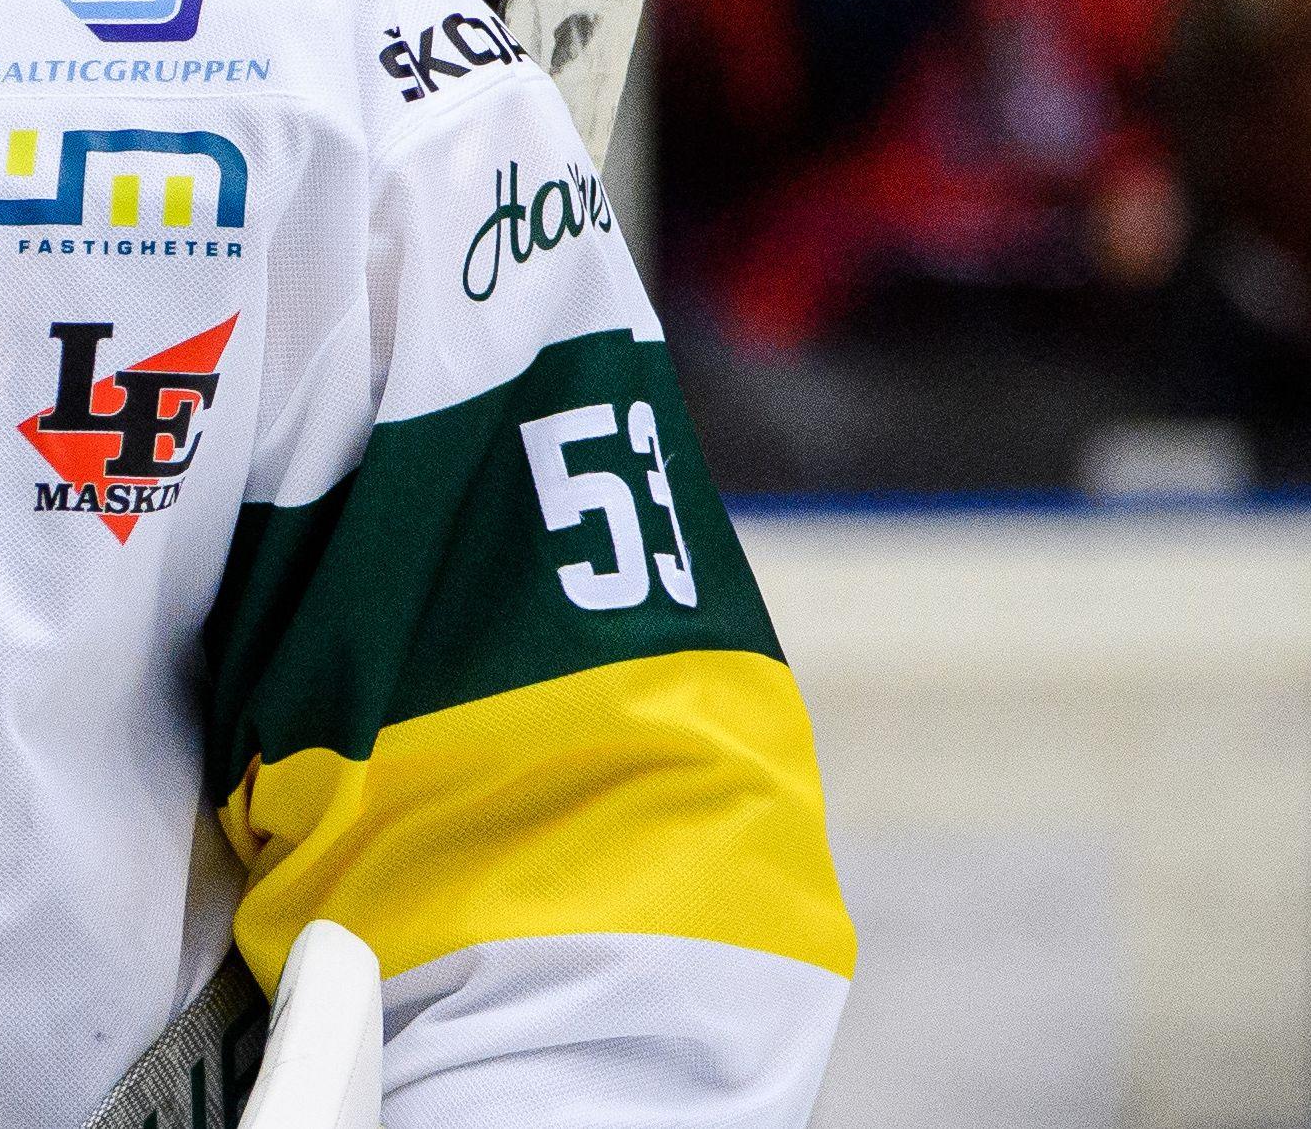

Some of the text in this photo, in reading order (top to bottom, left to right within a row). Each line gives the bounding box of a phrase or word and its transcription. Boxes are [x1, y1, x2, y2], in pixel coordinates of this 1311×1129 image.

[19, 239, 243, 259] FASTIGHETER
[37, 321, 221, 479] LE
[519, 400, 698, 611] 53
